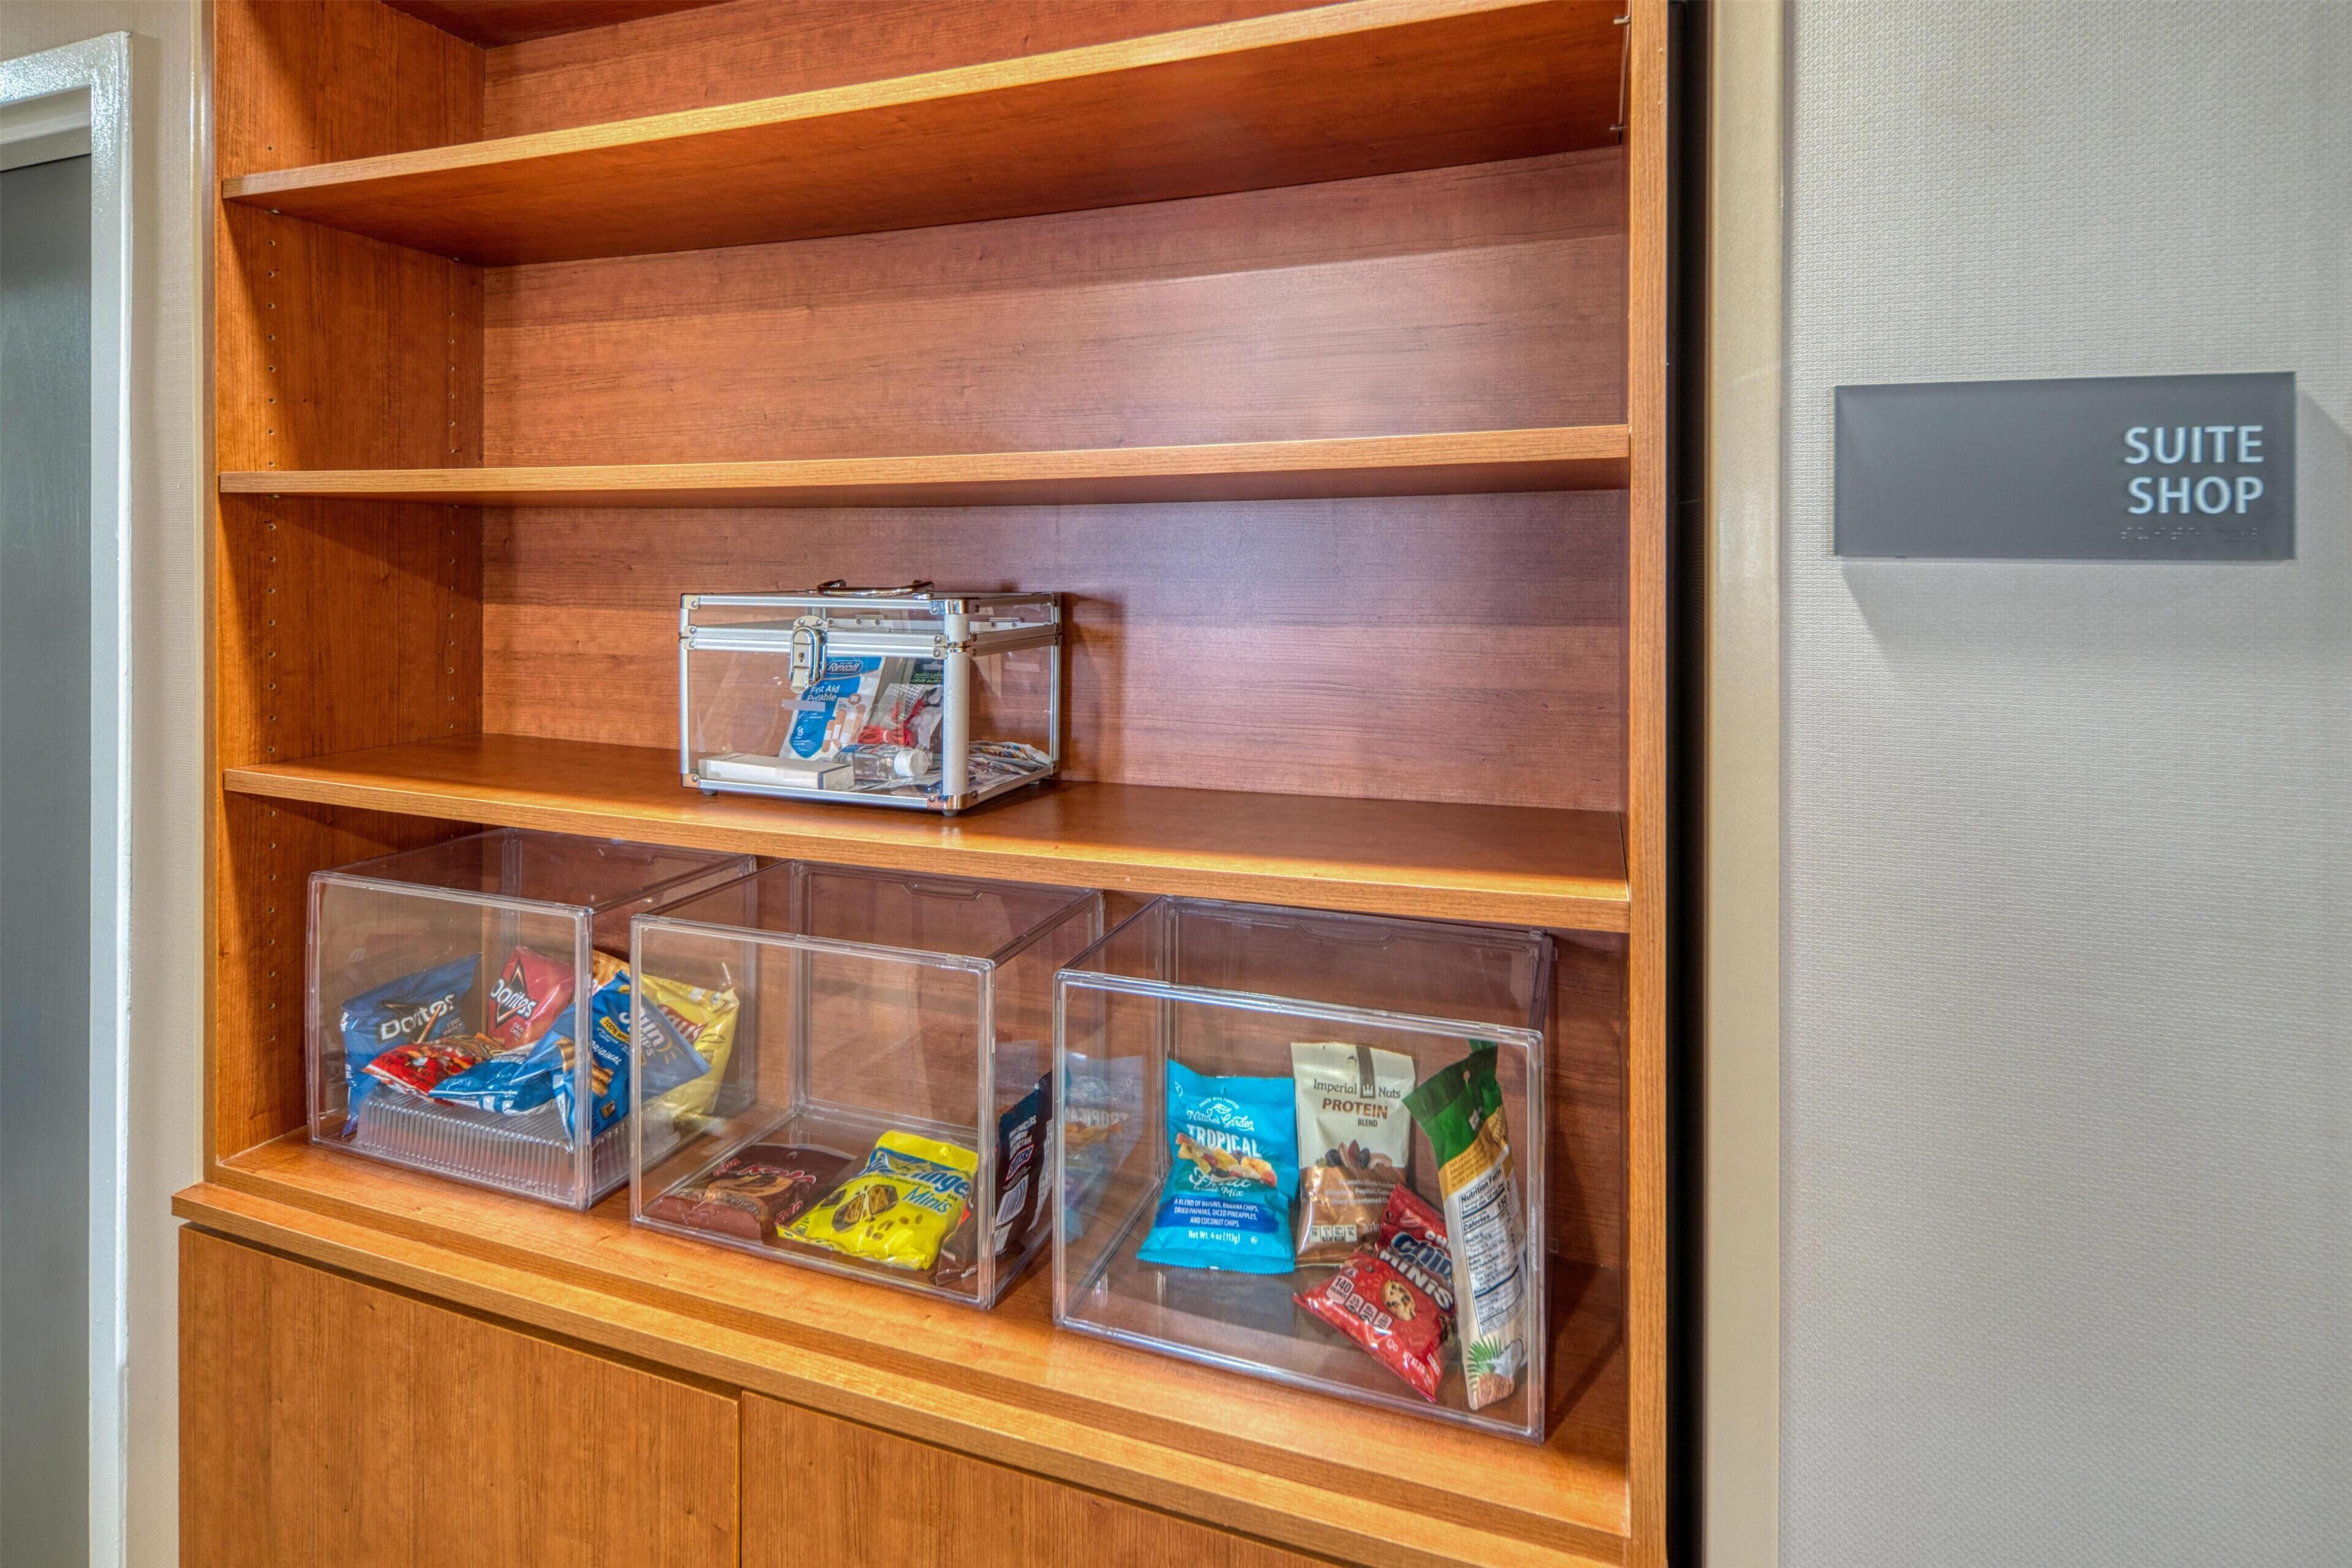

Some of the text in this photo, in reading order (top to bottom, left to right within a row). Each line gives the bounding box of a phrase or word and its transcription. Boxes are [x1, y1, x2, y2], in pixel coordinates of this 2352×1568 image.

[2124, 424, 2264, 464] SUITE
[2127, 476, 2264, 514] SHOP
[827, 663, 861, 672] Rexall
[490, 978, 537, 1018] Doritos
[381, 994, 454, 1040] Doritos
[1314, 1078, 1401, 1099] Imperial Nuts
[1322, 1098, 1389, 1120] PROTEIN
[1186, 1110, 1255, 1132] Nature's Garden
[1357, 1118, 1378, 1127] BLEND
[1186, 1124, 1262, 1158] TROPICAL
[902, 1186, 952, 1215] Minis
[1221, 1187, 1245, 1197] Mix
[1461, 1180, 1489, 1204] Nutrition
[1227, 1211, 1257, 1221] PINEAPPLES,
[1243, 1204, 1259, 1213] CHIPS,
[1463, 1213, 1490, 1231] Calories
[1498, 1195, 1507, 1210] 150
[1188, 1230, 1199, 1238] Net
[1223, 1232, 1240, 1245] (113g)
[1392, 1231, 1453, 1281] Chip
[1335, 1276, 1352, 1293] 140
